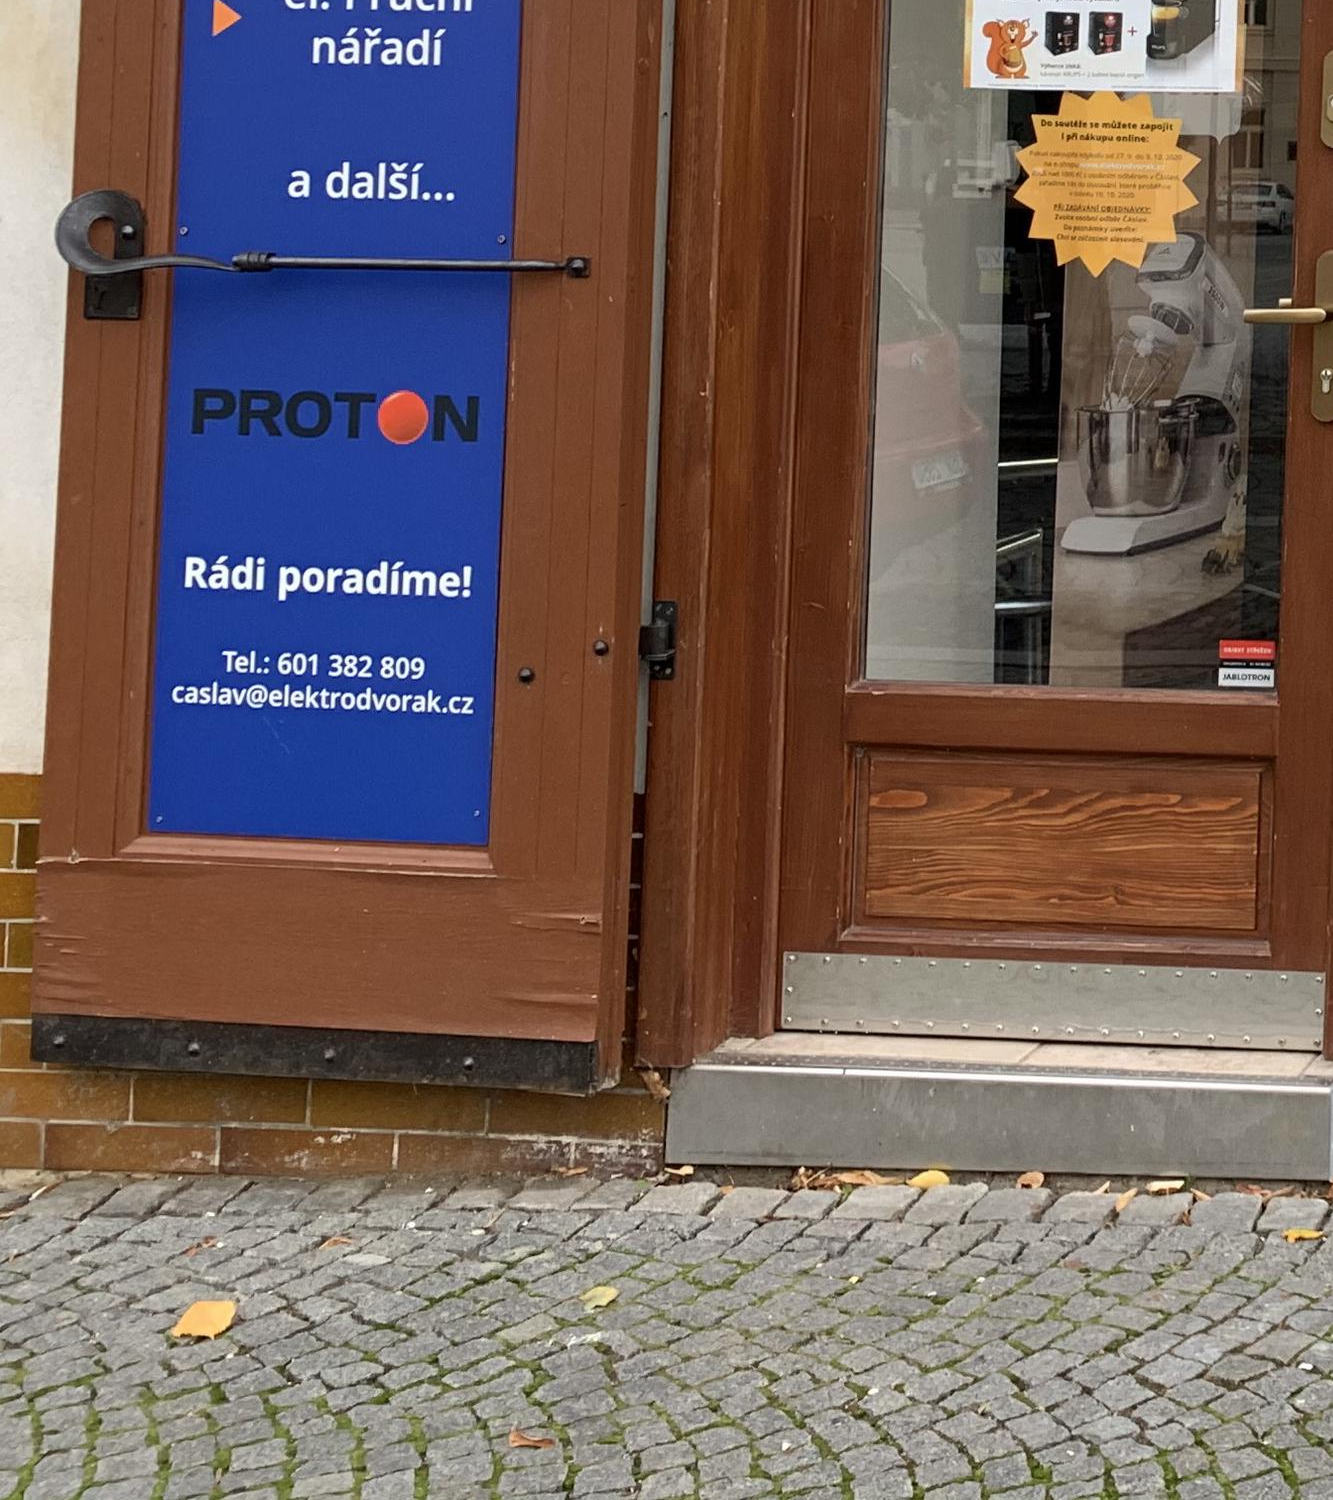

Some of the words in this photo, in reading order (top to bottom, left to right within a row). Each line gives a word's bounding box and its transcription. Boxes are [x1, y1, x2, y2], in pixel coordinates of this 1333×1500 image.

[312, 28, 446, 66] nářadí
[1041, 119, 1053, 127] Do
[1102, 120, 1137, 129] můžete
[1140, 122, 1173, 132] zapojit
[1080, 133, 1113, 143] nákupu
[287, 170, 310, 198] a
[326, 162, 455, 201] další...
[192, 388, 480, 444] PROTON
[184, 556, 265, 591] Rádi
[278, 561, 472, 601] poradíme!
[222, 651, 269, 674] Tel.:
[277, 653, 318, 675] 601
[328, 655, 372, 678] 382
[380, 657, 425, 680] 809
[1223, 673, 1271, 681] JABLOTRON
[172, 682, 473, 714] caslav@elektrodvorak.cz
